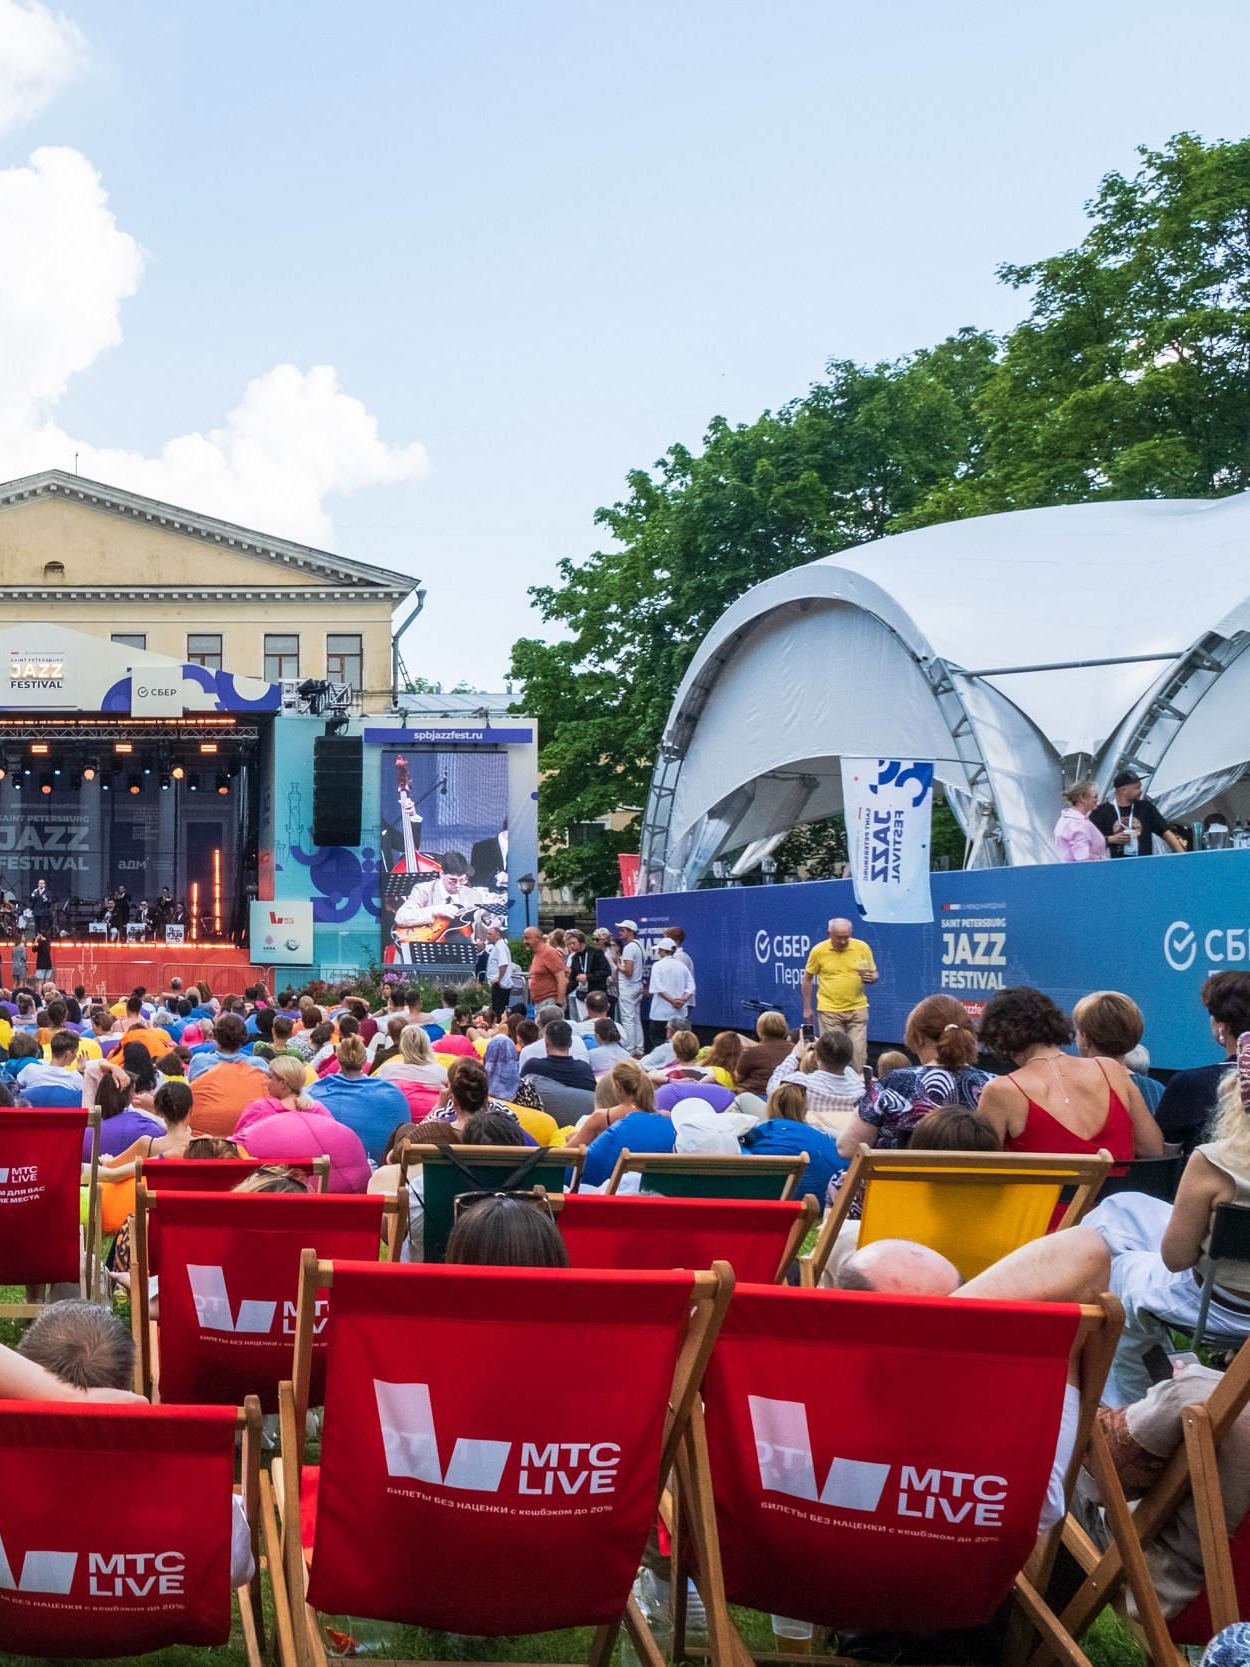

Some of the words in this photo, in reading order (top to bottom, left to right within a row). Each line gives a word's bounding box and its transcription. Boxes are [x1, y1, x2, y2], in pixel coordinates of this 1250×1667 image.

[11, 663, 63, 679] JAZZ
[151, 688, 177, 696] СБЕР
[413, 730, 483, 741] spbjazzfest.ru
[27, 815, 90, 823] PETERSBURG
[941, 918, 961, 928] SAINT
[962, 918, 1006, 928] PETERSBURG
[773, 935, 810, 957] СБЕР
[942, 933, 1006, 965] JAZZ
[1205, 928, 1250, 961] СБ
[941, 970, 1006, 990] FESTIVAL
[11, 1166, 38, 1176] МТС
[11, 1174, 38, 1183] LIVE
[10, 1194, 40, 1203] МЕСТА
[521, 1442, 621, 1467] МТС
[518, 1470, 617, 1495] LIVE
[900, 1465, 1008, 1501] МТС
[386, 1487, 431, 1503] БИЛЕТЫ
[434, 1497, 454, 1508] БЕЗ
[456, 1502, 508, 1515] НАЦЕНКИ
[519, 1508, 572, 1516] кешбэком
[590, 1504, 613, 1514] 20%
[897, 1492, 1005, 1527] LIVE
[761, 1501, 807, 1518] БИЛЕТЫ
[809, 1513, 831, 1525] БЕЗ
[833, 1519, 886, 1533] НАЦЕНКИ
[897, 1528, 955, 1542] кешбэком
[957, 1535, 972, 1543] до
[975, 1535, 999, 1543] 20%
[89, 1551, 185, 1574] МТС
[90, 1575, 184, 1596] LIVE
[12, 1598, 31, 1606] БЕЗ
[33, 1601, 82, 1610] НАЦЕНКИ
